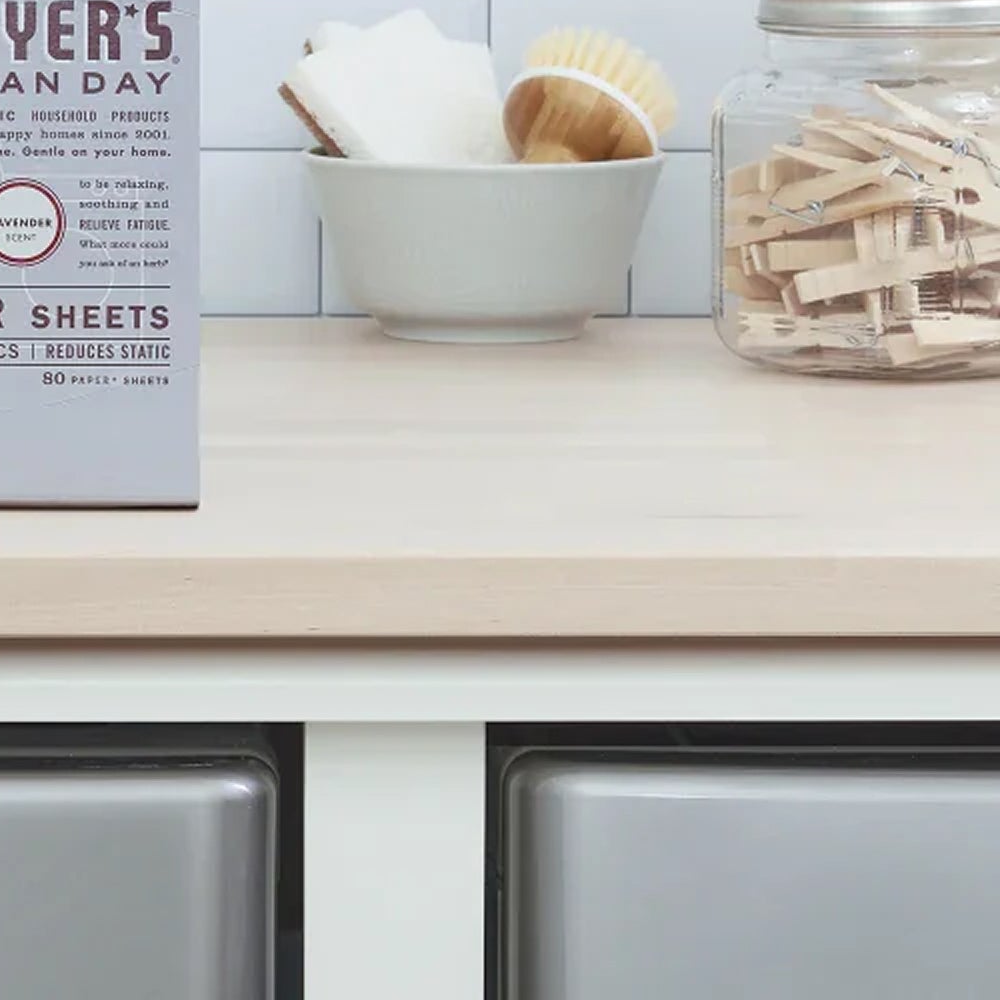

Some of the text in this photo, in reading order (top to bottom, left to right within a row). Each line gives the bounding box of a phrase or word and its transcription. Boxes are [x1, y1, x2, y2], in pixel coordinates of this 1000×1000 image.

[83, 71, 172, 94] DAY
[31, 110, 97, 122] HOUSEHOLD
[111, 110, 170, 122] PRODUCTS
[40, 129, 85, 139] homes
[91, 129, 129, 139] since
[22, 145, 66, 157] Gentle
[71, 148, 88, 157] on
[94, 148, 125, 159] your
[131, 146, 172, 157] home.
[79, 180, 91, 189] to
[96, 179, 109, 189] be
[79, 199, 169, 210] soothing and
[31, 305, 170, 330] SHEETS
[45, 343, 115, 360] REDUCES
[121, 343, 171, 360] STATIC
[42, 371, 66, 385] 80
[123, 376, 169, 385] SHEETS
